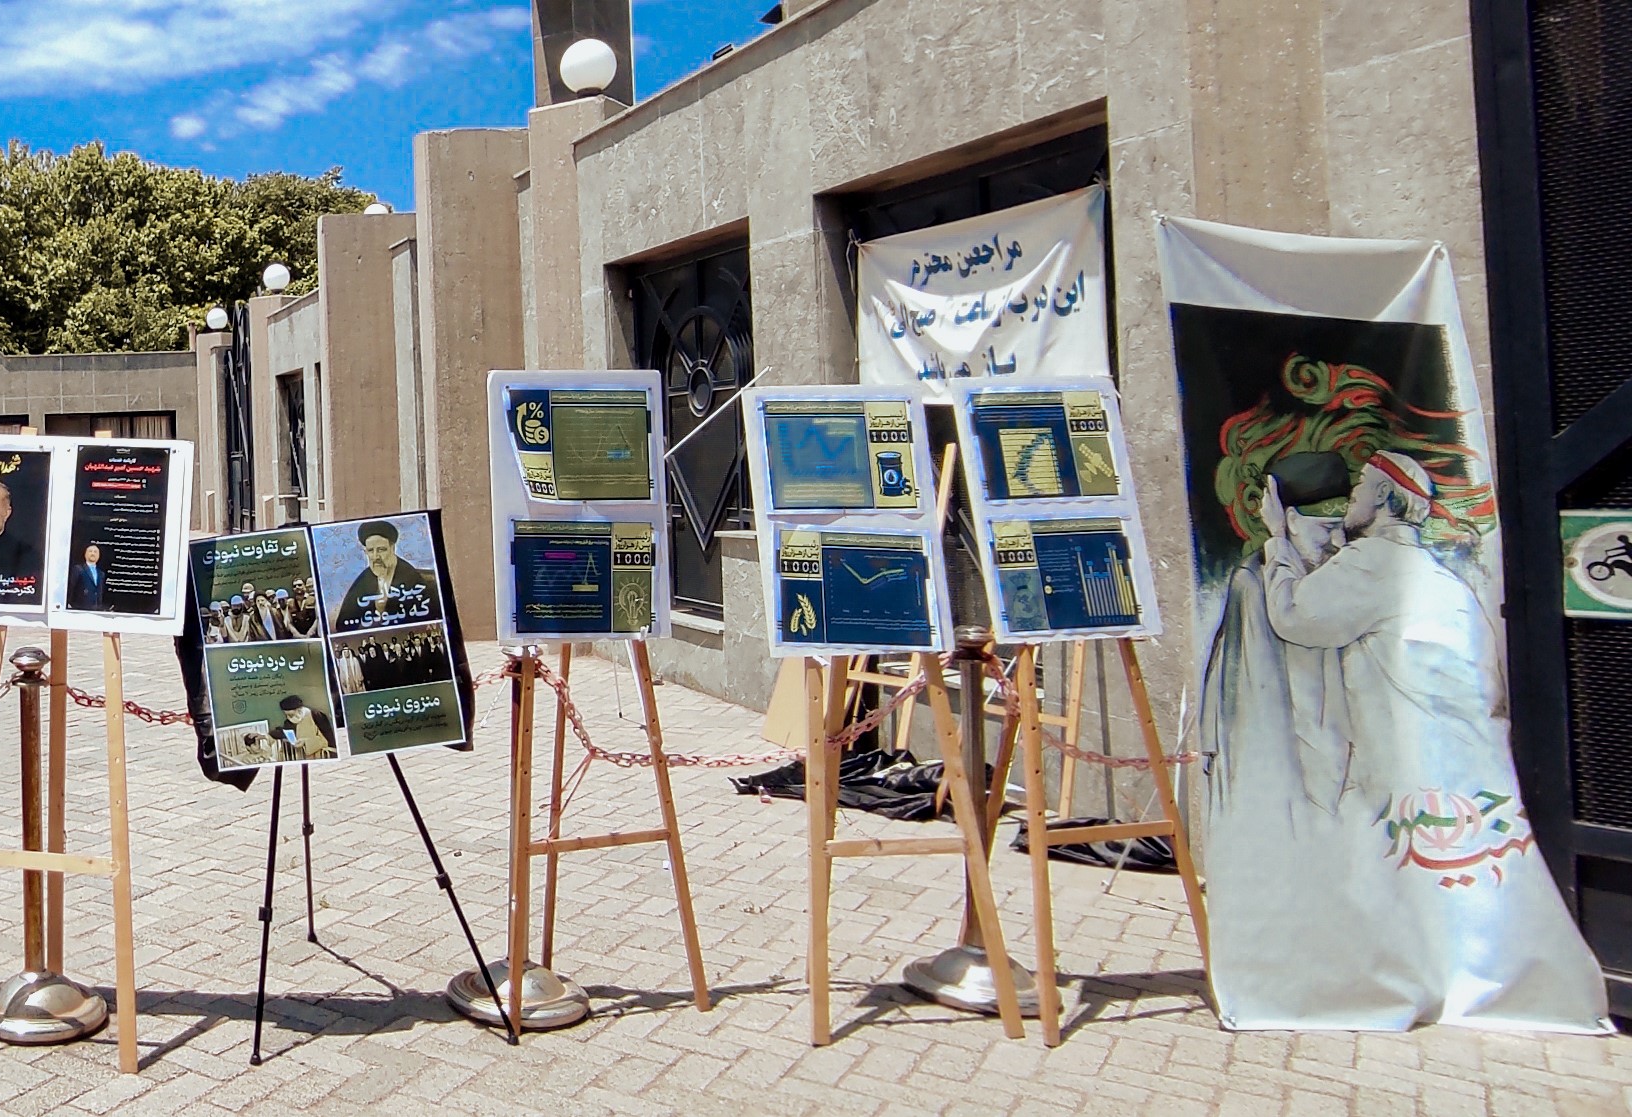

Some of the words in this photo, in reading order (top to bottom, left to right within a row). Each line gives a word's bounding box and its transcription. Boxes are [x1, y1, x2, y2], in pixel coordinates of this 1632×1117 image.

[956, 233, 1023, 278] مراجعین
[911, 251, 953, 287] محترم
[1054, 269, 1085, 317] این
[1008, 284, 1047, 322] درب
[1071, 420, 1103, 431] 1000
[871, 431, 907, 442] 1000
[84, 462, 114, 472] عبداللهیان
[114, 463, 126, 472] امیر
[126, 464, 144, 474] حسین
[144, 465, 161, 474] شهید
[530, 482, 554, 494] 1000
[202, 544, 240, 565] نبودی
[241, 539, 279, 559] تفاوت
[281, 541, 298, 557] بی
[1000, 551, 1034, 562] 1000
[616, 554, 650, 565] 1000
[783, 561, 819, 573] 1000
[357, 581, 427, 608] چیزهایی
[407, 597, 431, 618] که
[227, 654, 265, 673] نبودی
[266, 655, 286, 672] درد
[288, 655, 305, 671] بی
[364, 699, 401, 720] نبودی
[402, 695, 441, 715] منزوی
